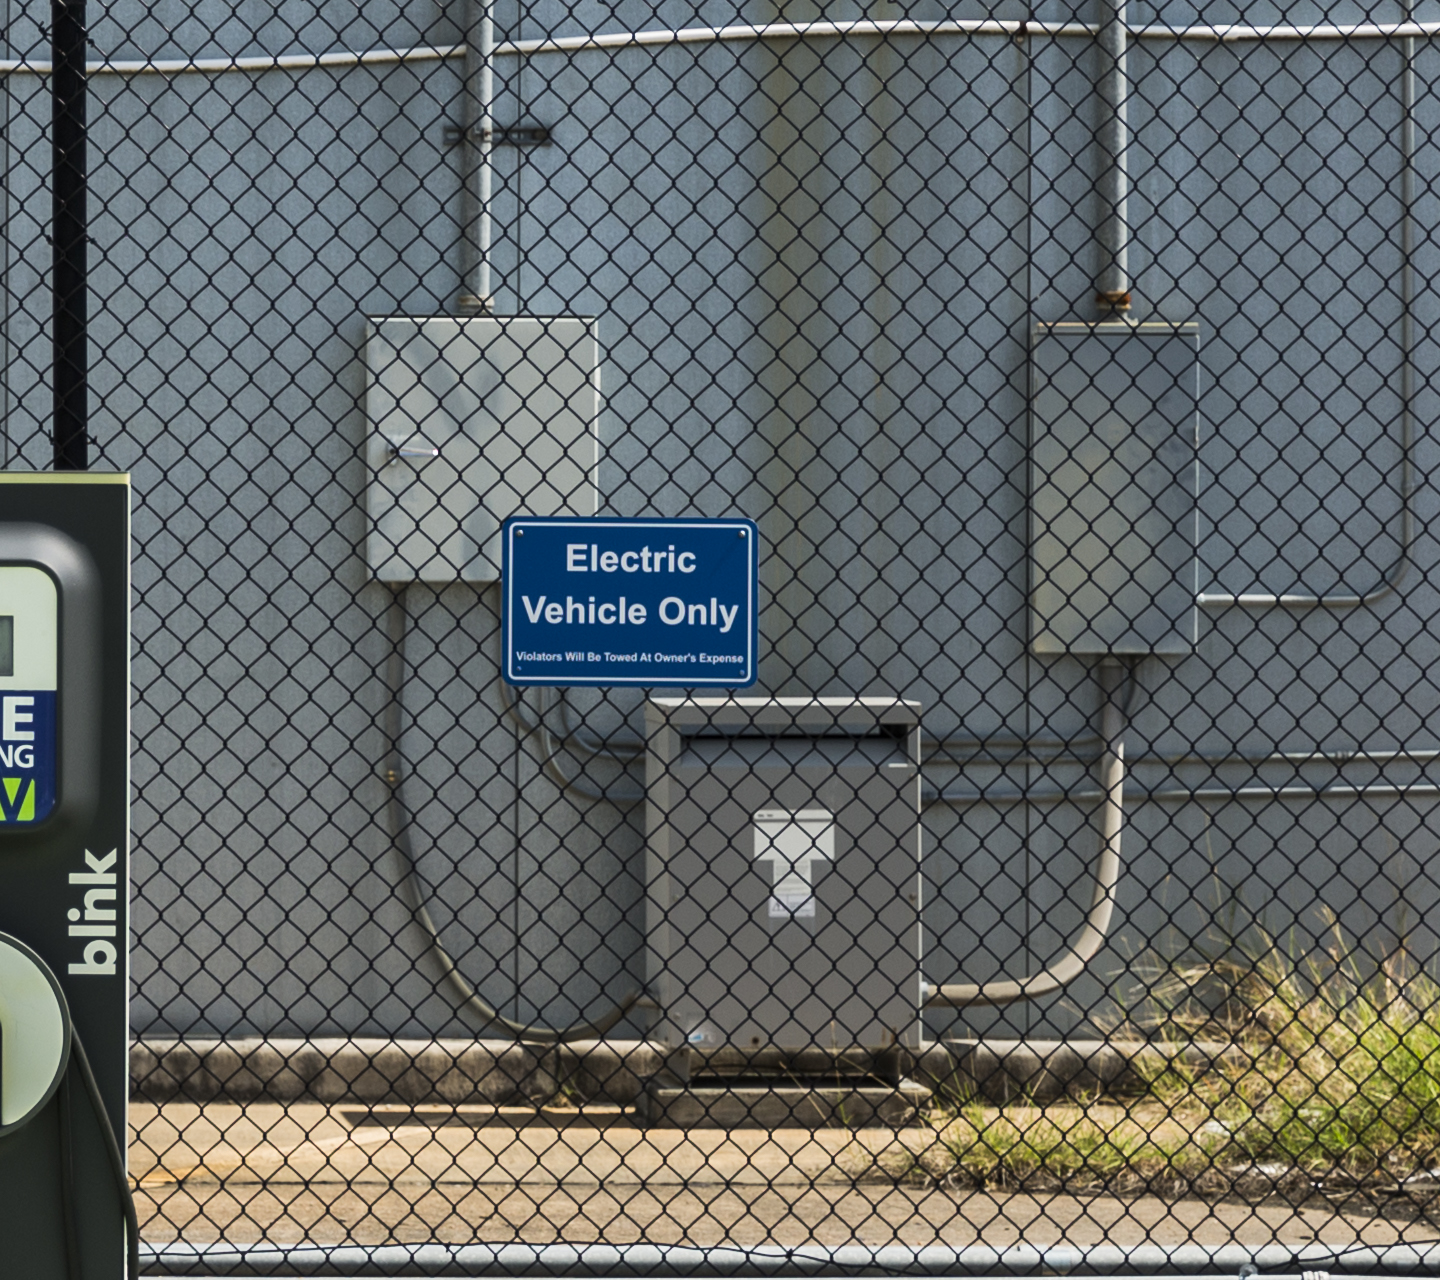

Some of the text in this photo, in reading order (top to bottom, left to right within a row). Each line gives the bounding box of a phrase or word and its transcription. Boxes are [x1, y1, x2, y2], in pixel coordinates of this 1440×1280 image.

[566, 543, 697, 574] Electric
[521, 595, 739, 633] Vehicle Only
[516, 651, 744, 665] Violators Will Be Towed At Owner's Expense
[66, 847, 118, 975] blink
